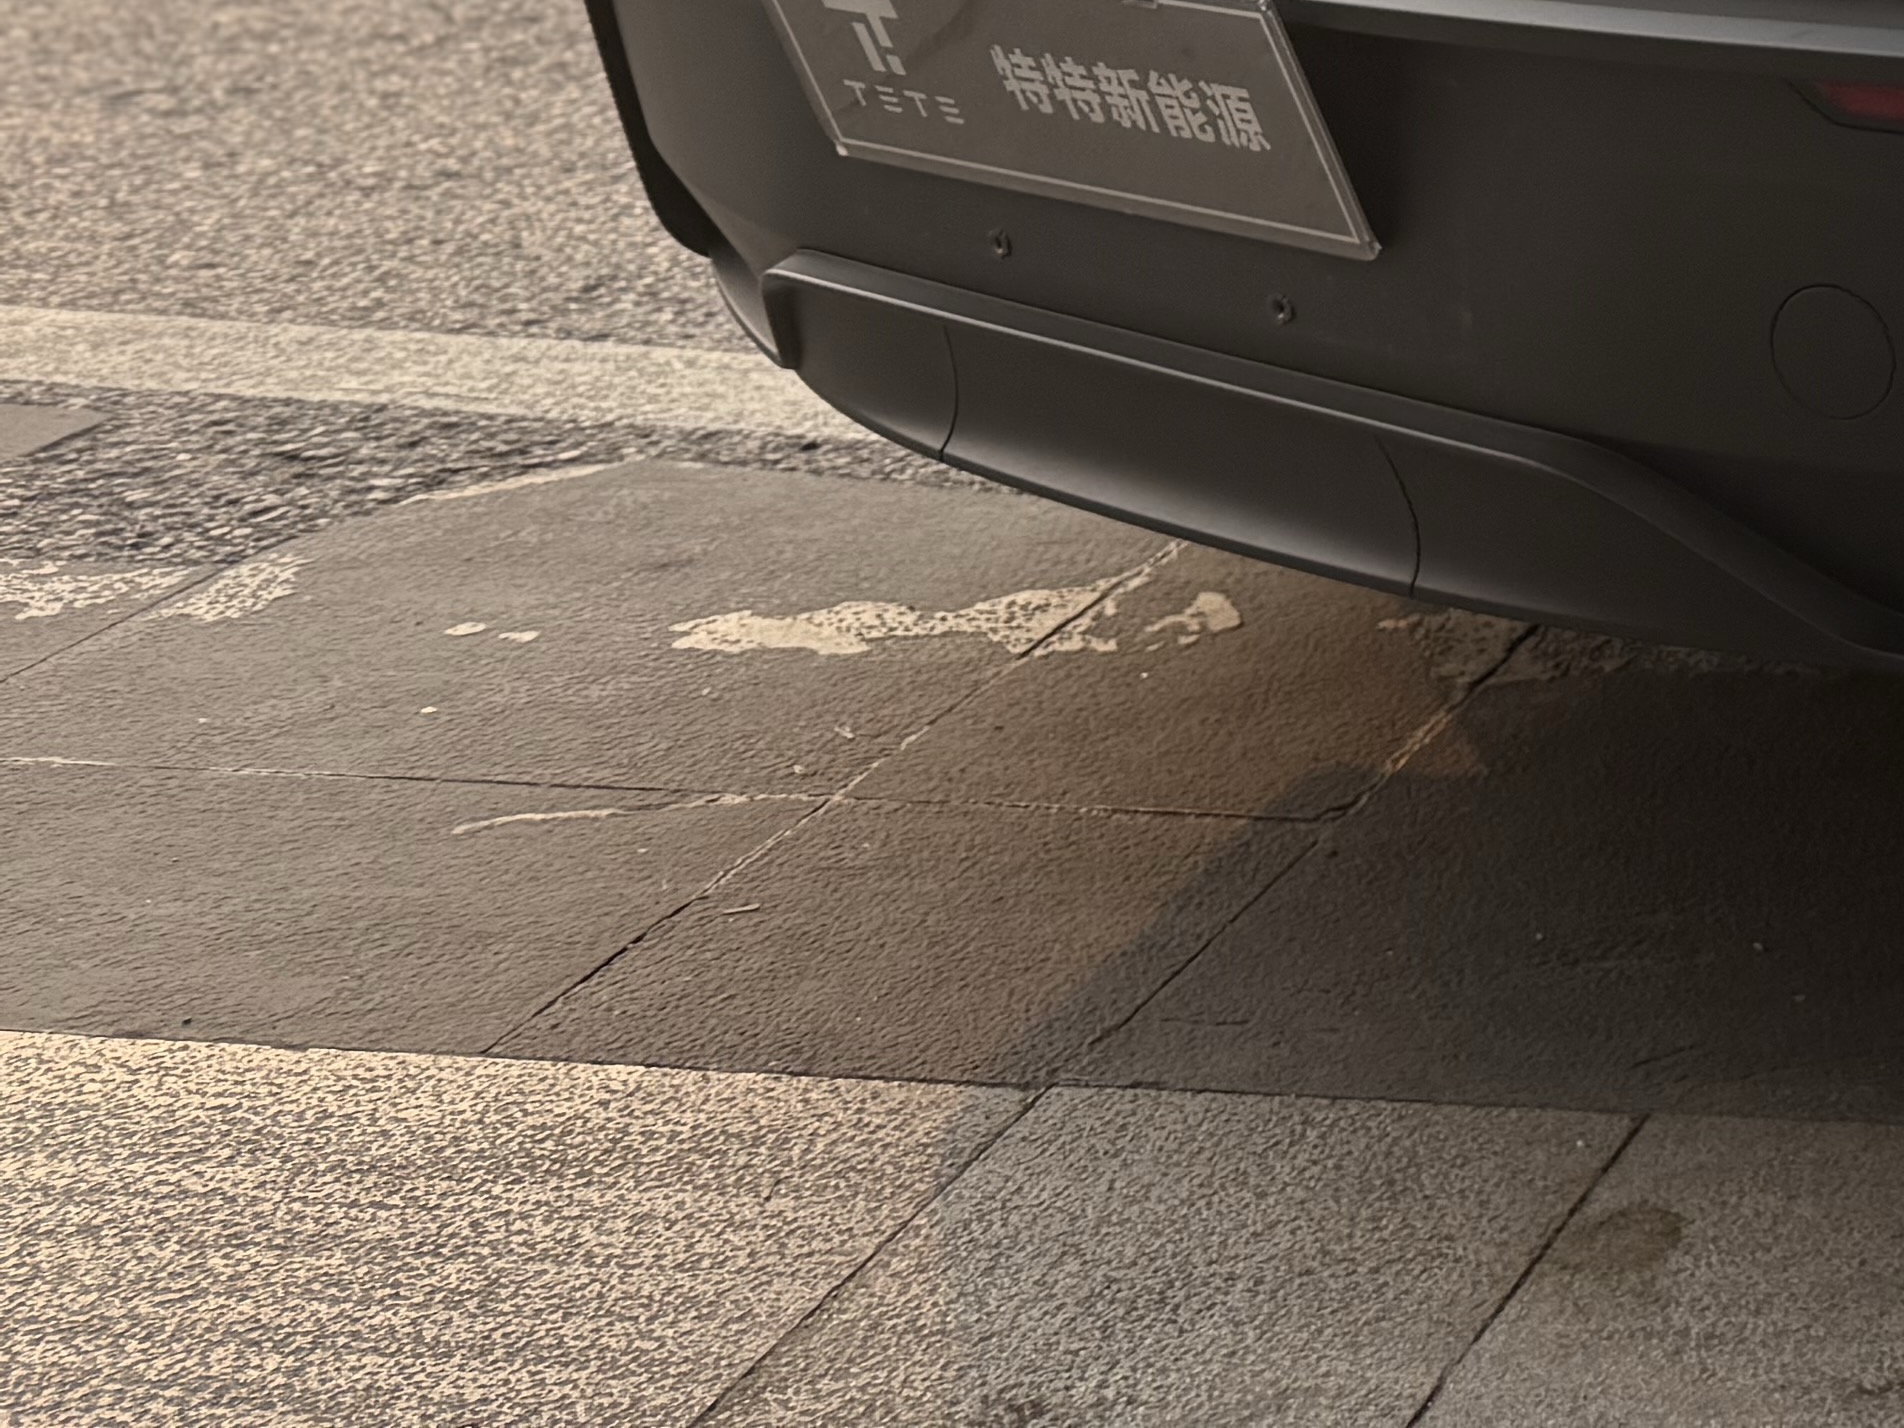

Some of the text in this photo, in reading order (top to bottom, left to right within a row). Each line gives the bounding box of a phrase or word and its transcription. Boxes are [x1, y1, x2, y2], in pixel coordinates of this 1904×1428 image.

[843, 78, 965, 125] TETE
[990, 44, 1271, 151] 特特新能源
